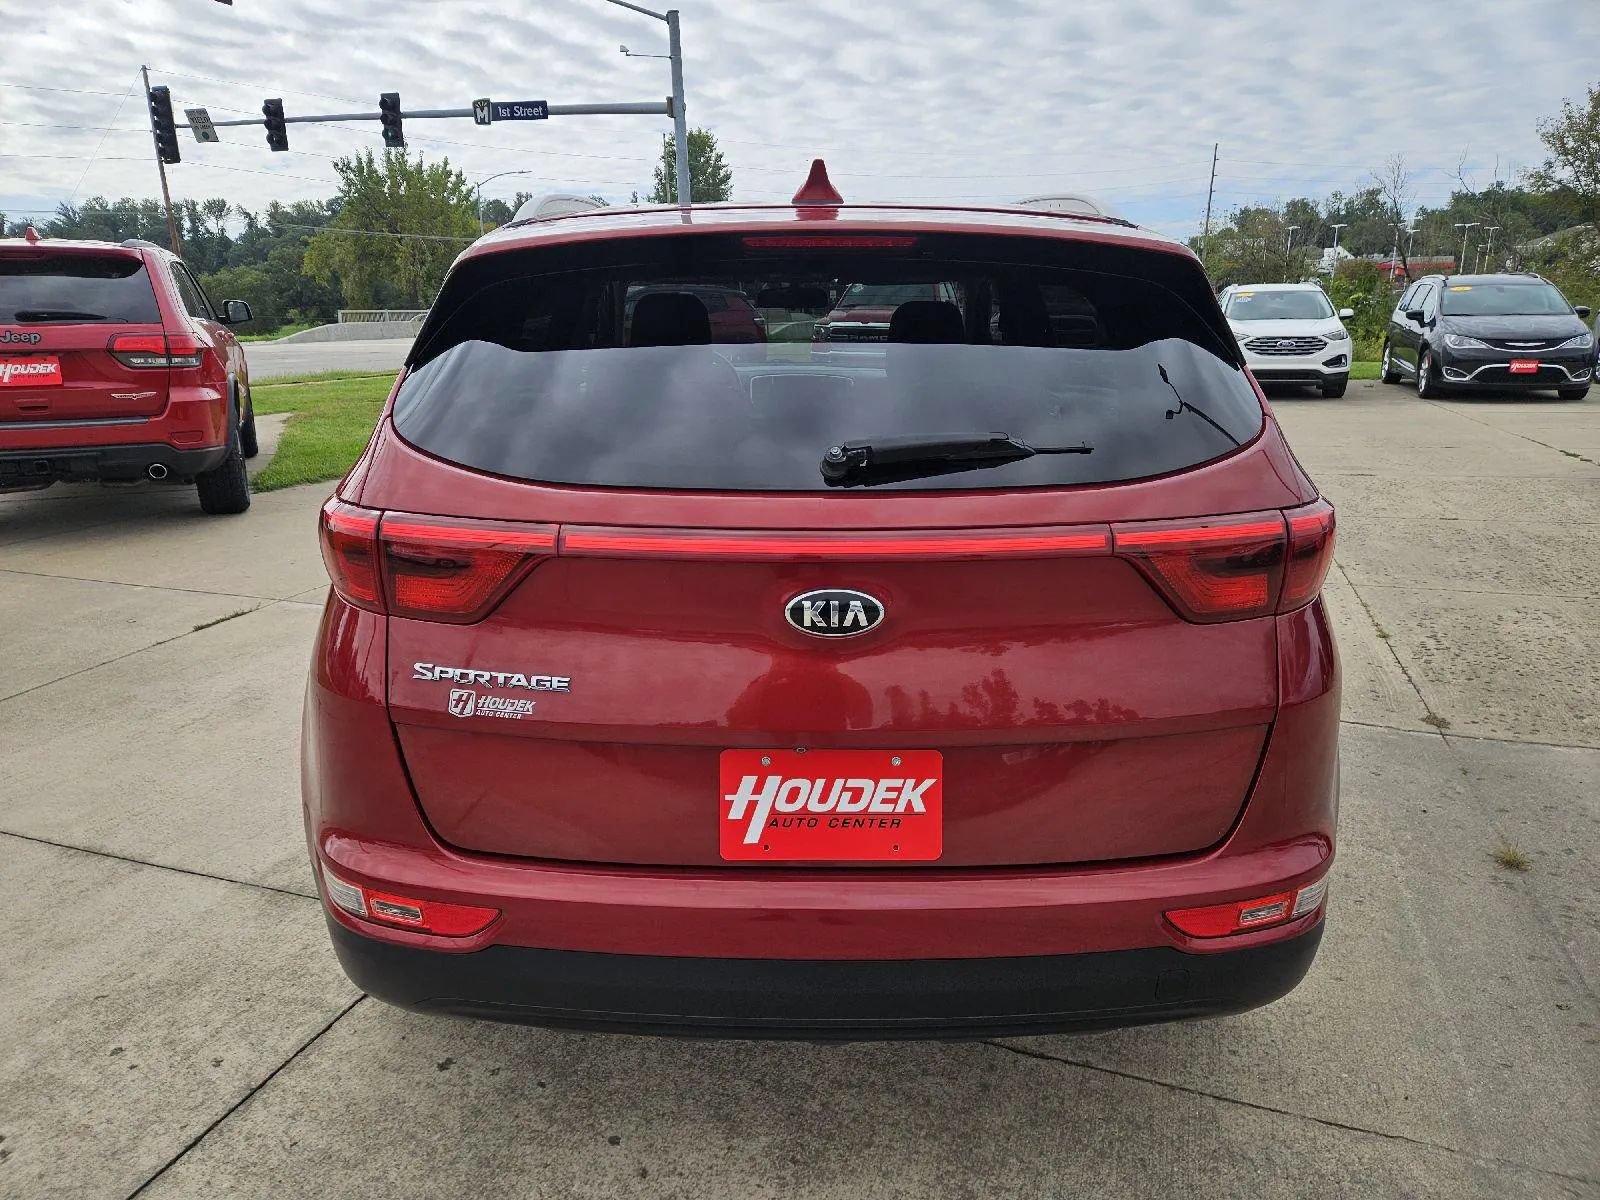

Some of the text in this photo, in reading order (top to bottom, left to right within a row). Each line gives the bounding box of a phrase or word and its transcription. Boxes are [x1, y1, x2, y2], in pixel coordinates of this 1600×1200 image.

[498, 105, 544, 117] 1st Street
[0, 331, 41, 345] Jeep
[801, 600, 869, 628] KIA
[412, 662, 571, 693] SPORTAGE
[477, 695, 537, 712] HOUDEK
[495, 712, 522, 720] CENTER
[724, 775, 938, 845] HOUDEK
[767, 817, 902, 829] AUTO CENTER
